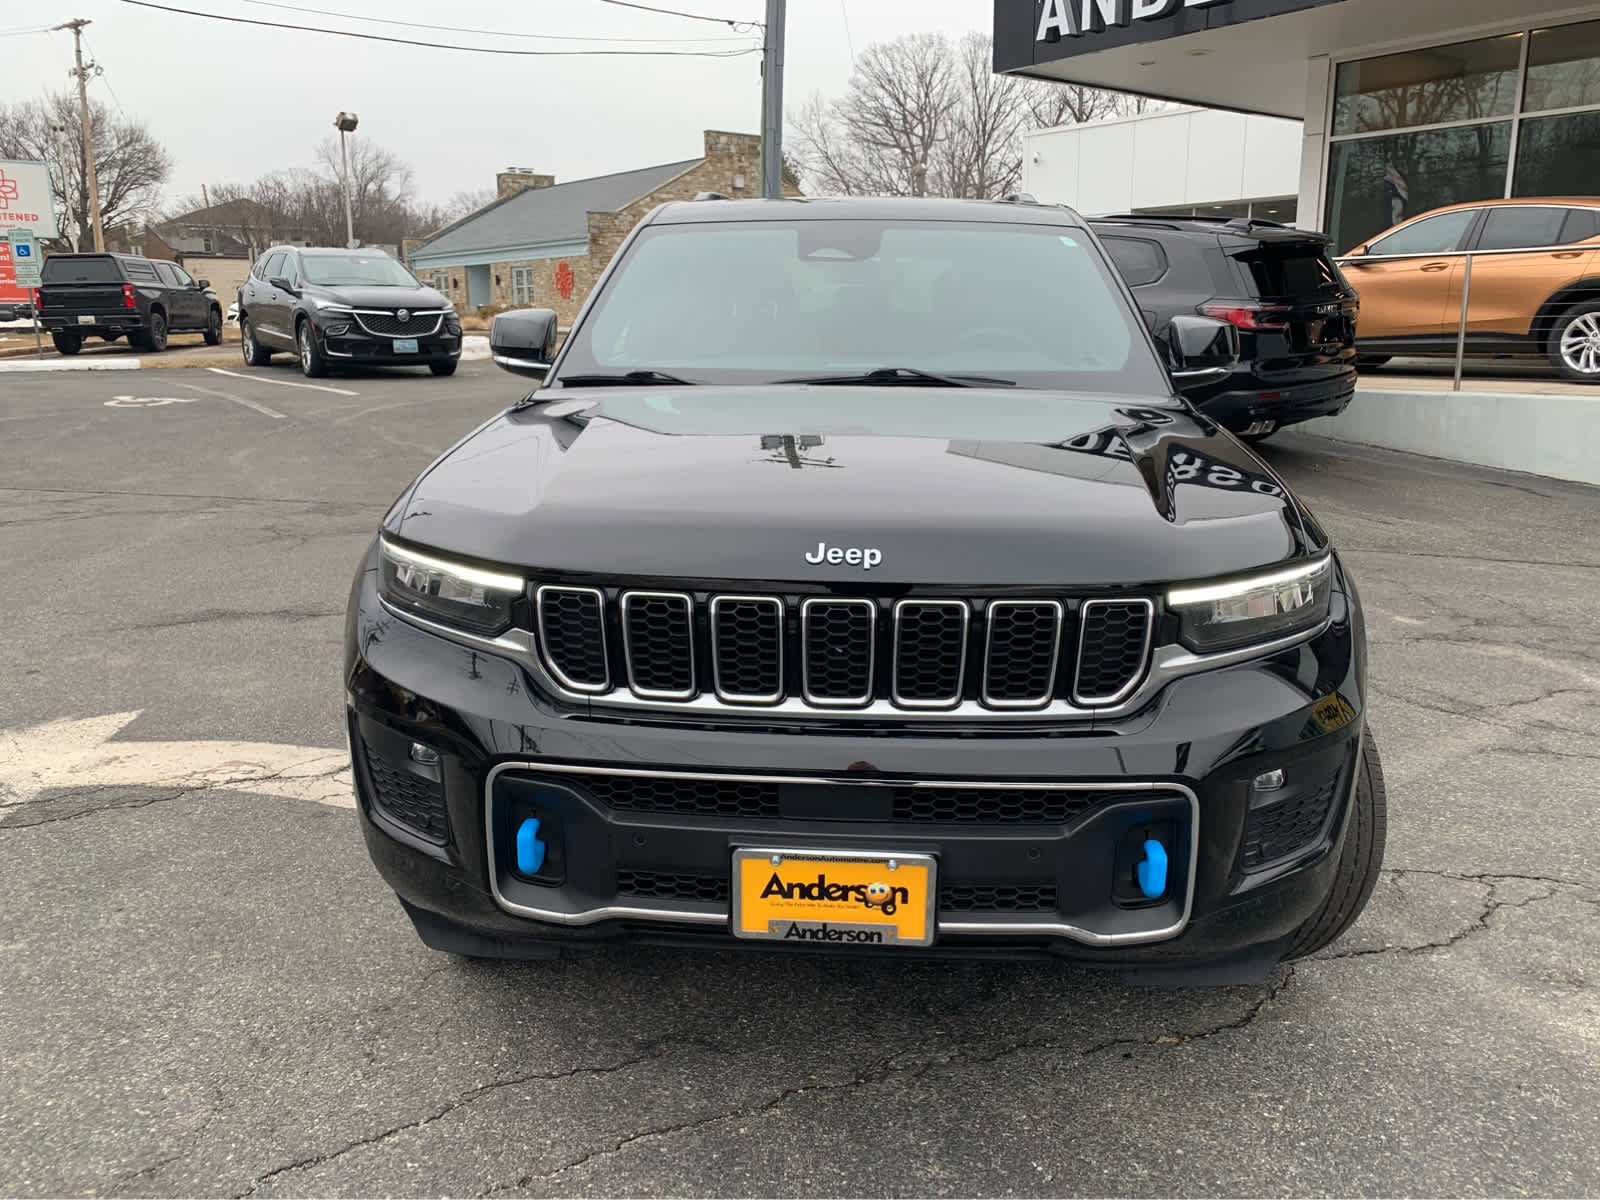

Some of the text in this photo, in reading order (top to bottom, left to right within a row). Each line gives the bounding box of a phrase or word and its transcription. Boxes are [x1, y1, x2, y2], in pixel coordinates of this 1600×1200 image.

[1035, 0, 1219, 41] AN
[0, 212, 39, 223] TENED
[805, 542, 882, 569] Jeep
[760, 872, 909, 905] Anderson
[784, 921, 882, 943] Anderson
